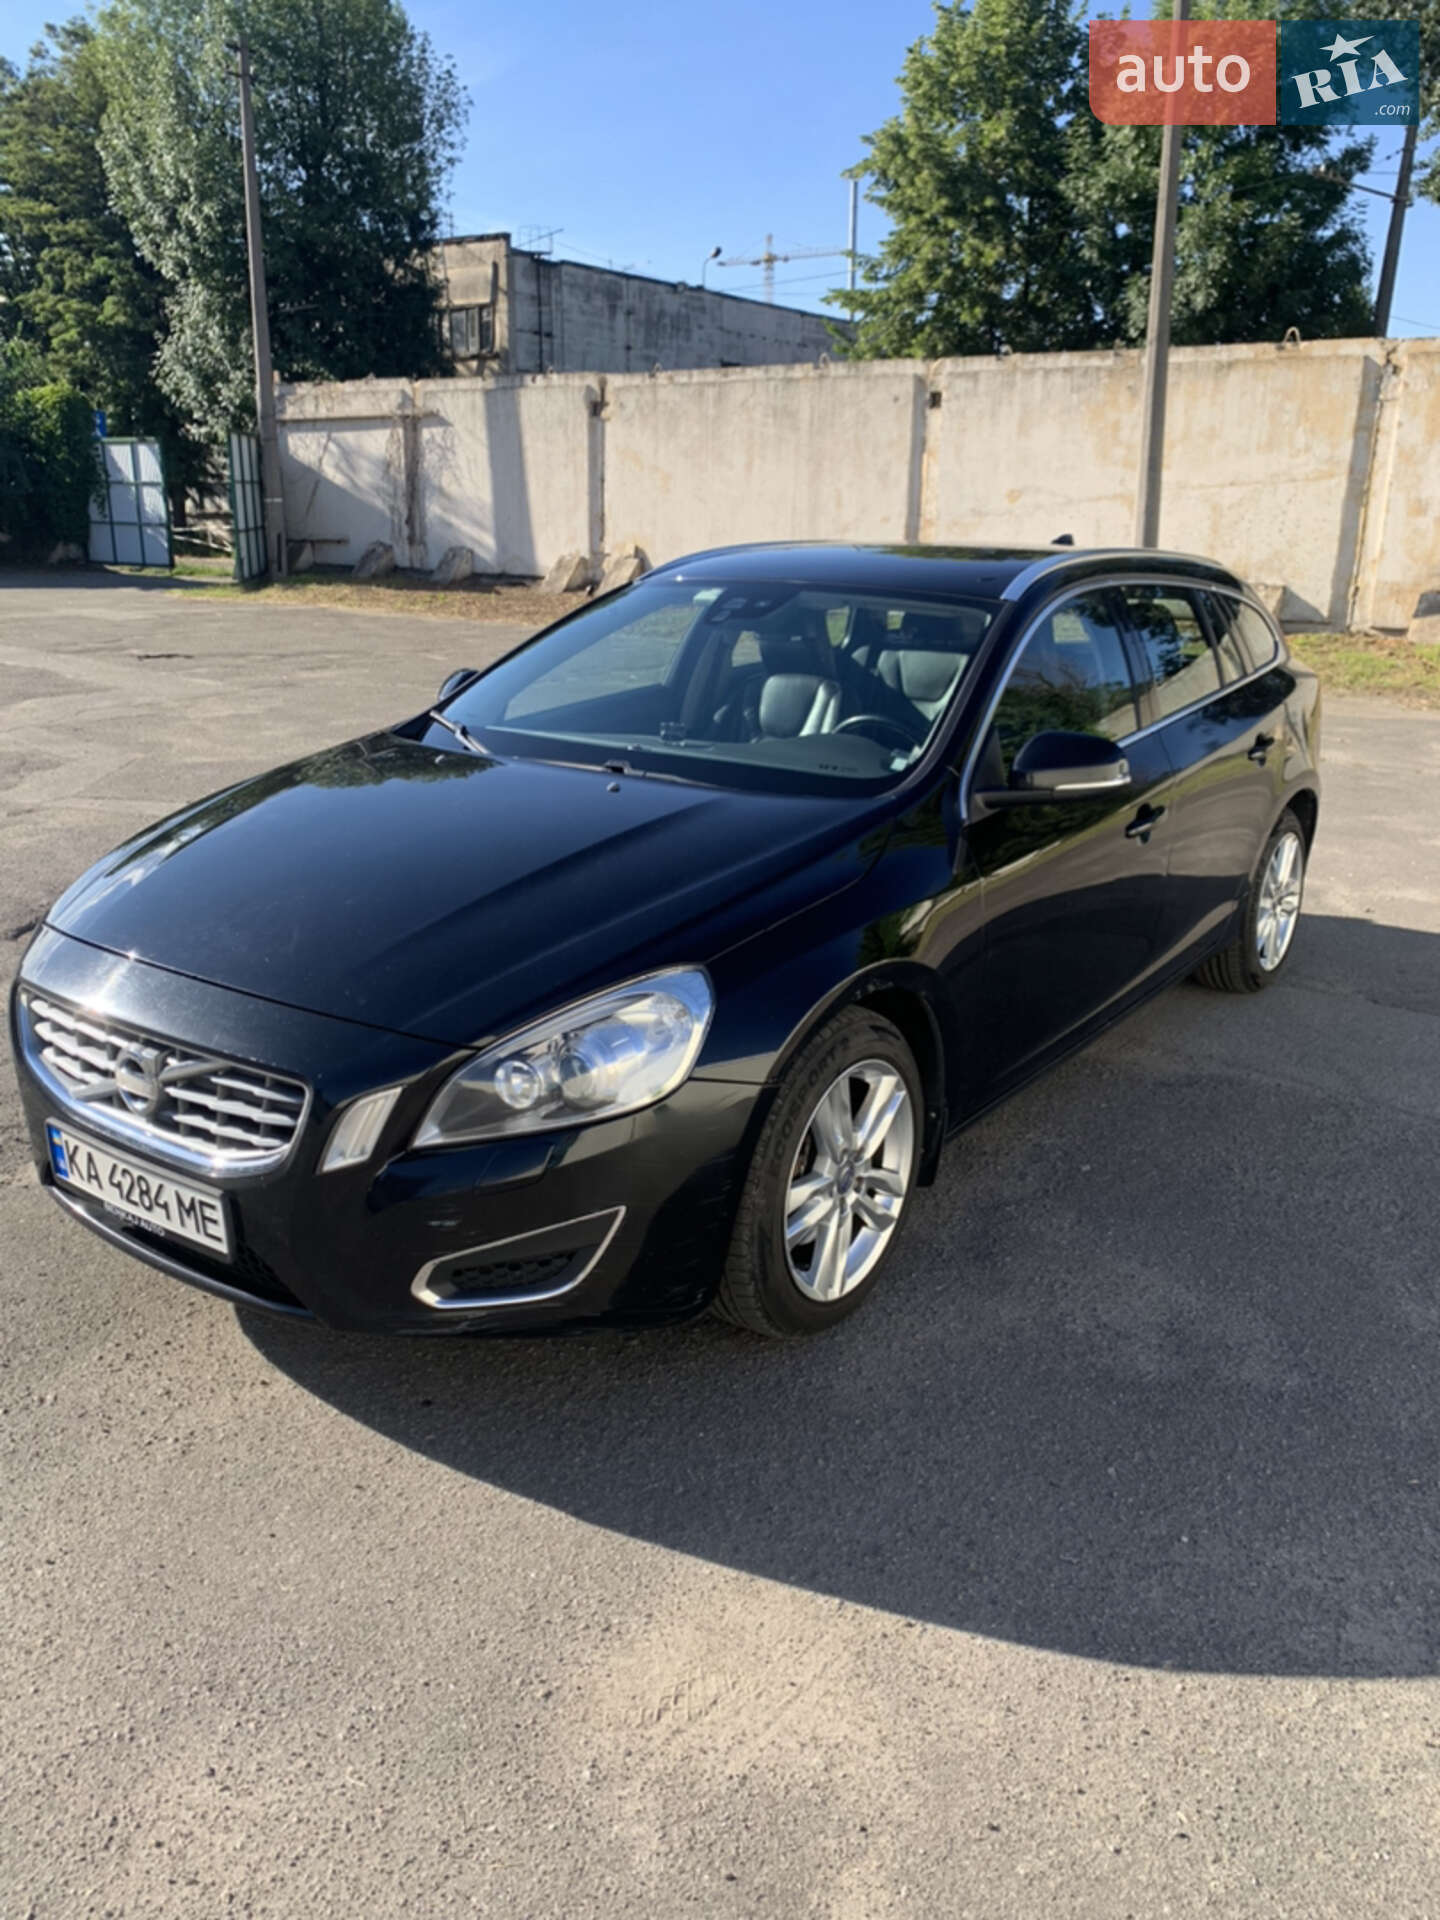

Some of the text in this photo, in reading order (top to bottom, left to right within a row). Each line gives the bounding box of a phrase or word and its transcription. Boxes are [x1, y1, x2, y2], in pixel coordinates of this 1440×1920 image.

[64, 1140, 103, 1190] KA
[108, 1163, 171, 1221] 4284
[174, 1190, 223, 1243] ME
